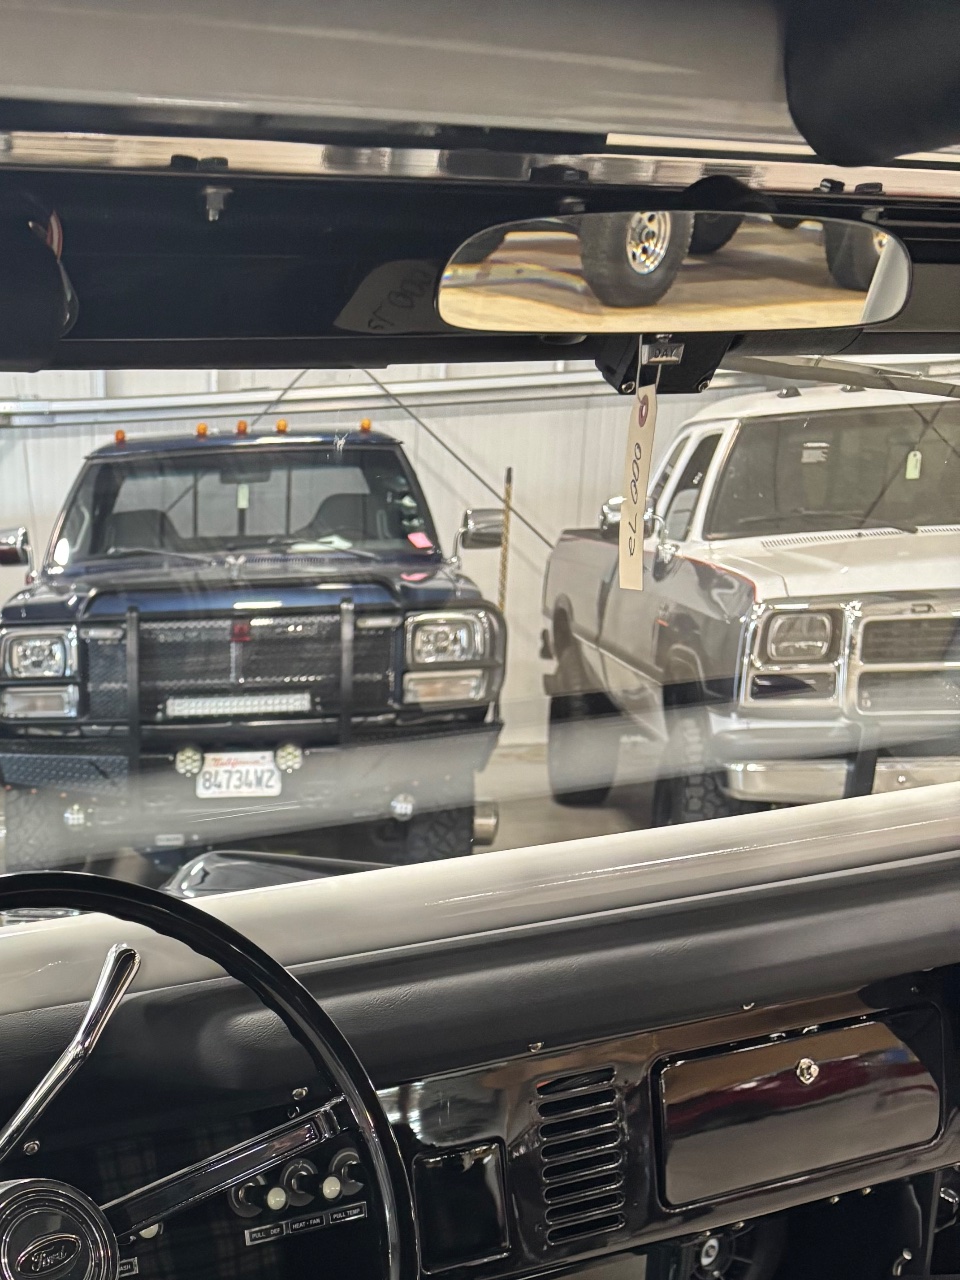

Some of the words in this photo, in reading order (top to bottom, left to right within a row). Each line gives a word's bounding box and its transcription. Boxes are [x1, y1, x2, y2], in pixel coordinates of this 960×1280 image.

[333, 1211, 346, 1219] PULL
[346, 1208, 361, 1216] TEMP
[292, 1222, 306, 1230] HEAT
[251, 1232, 265, 1240] PULL
[31, 1245, 67, 1272] Ford
